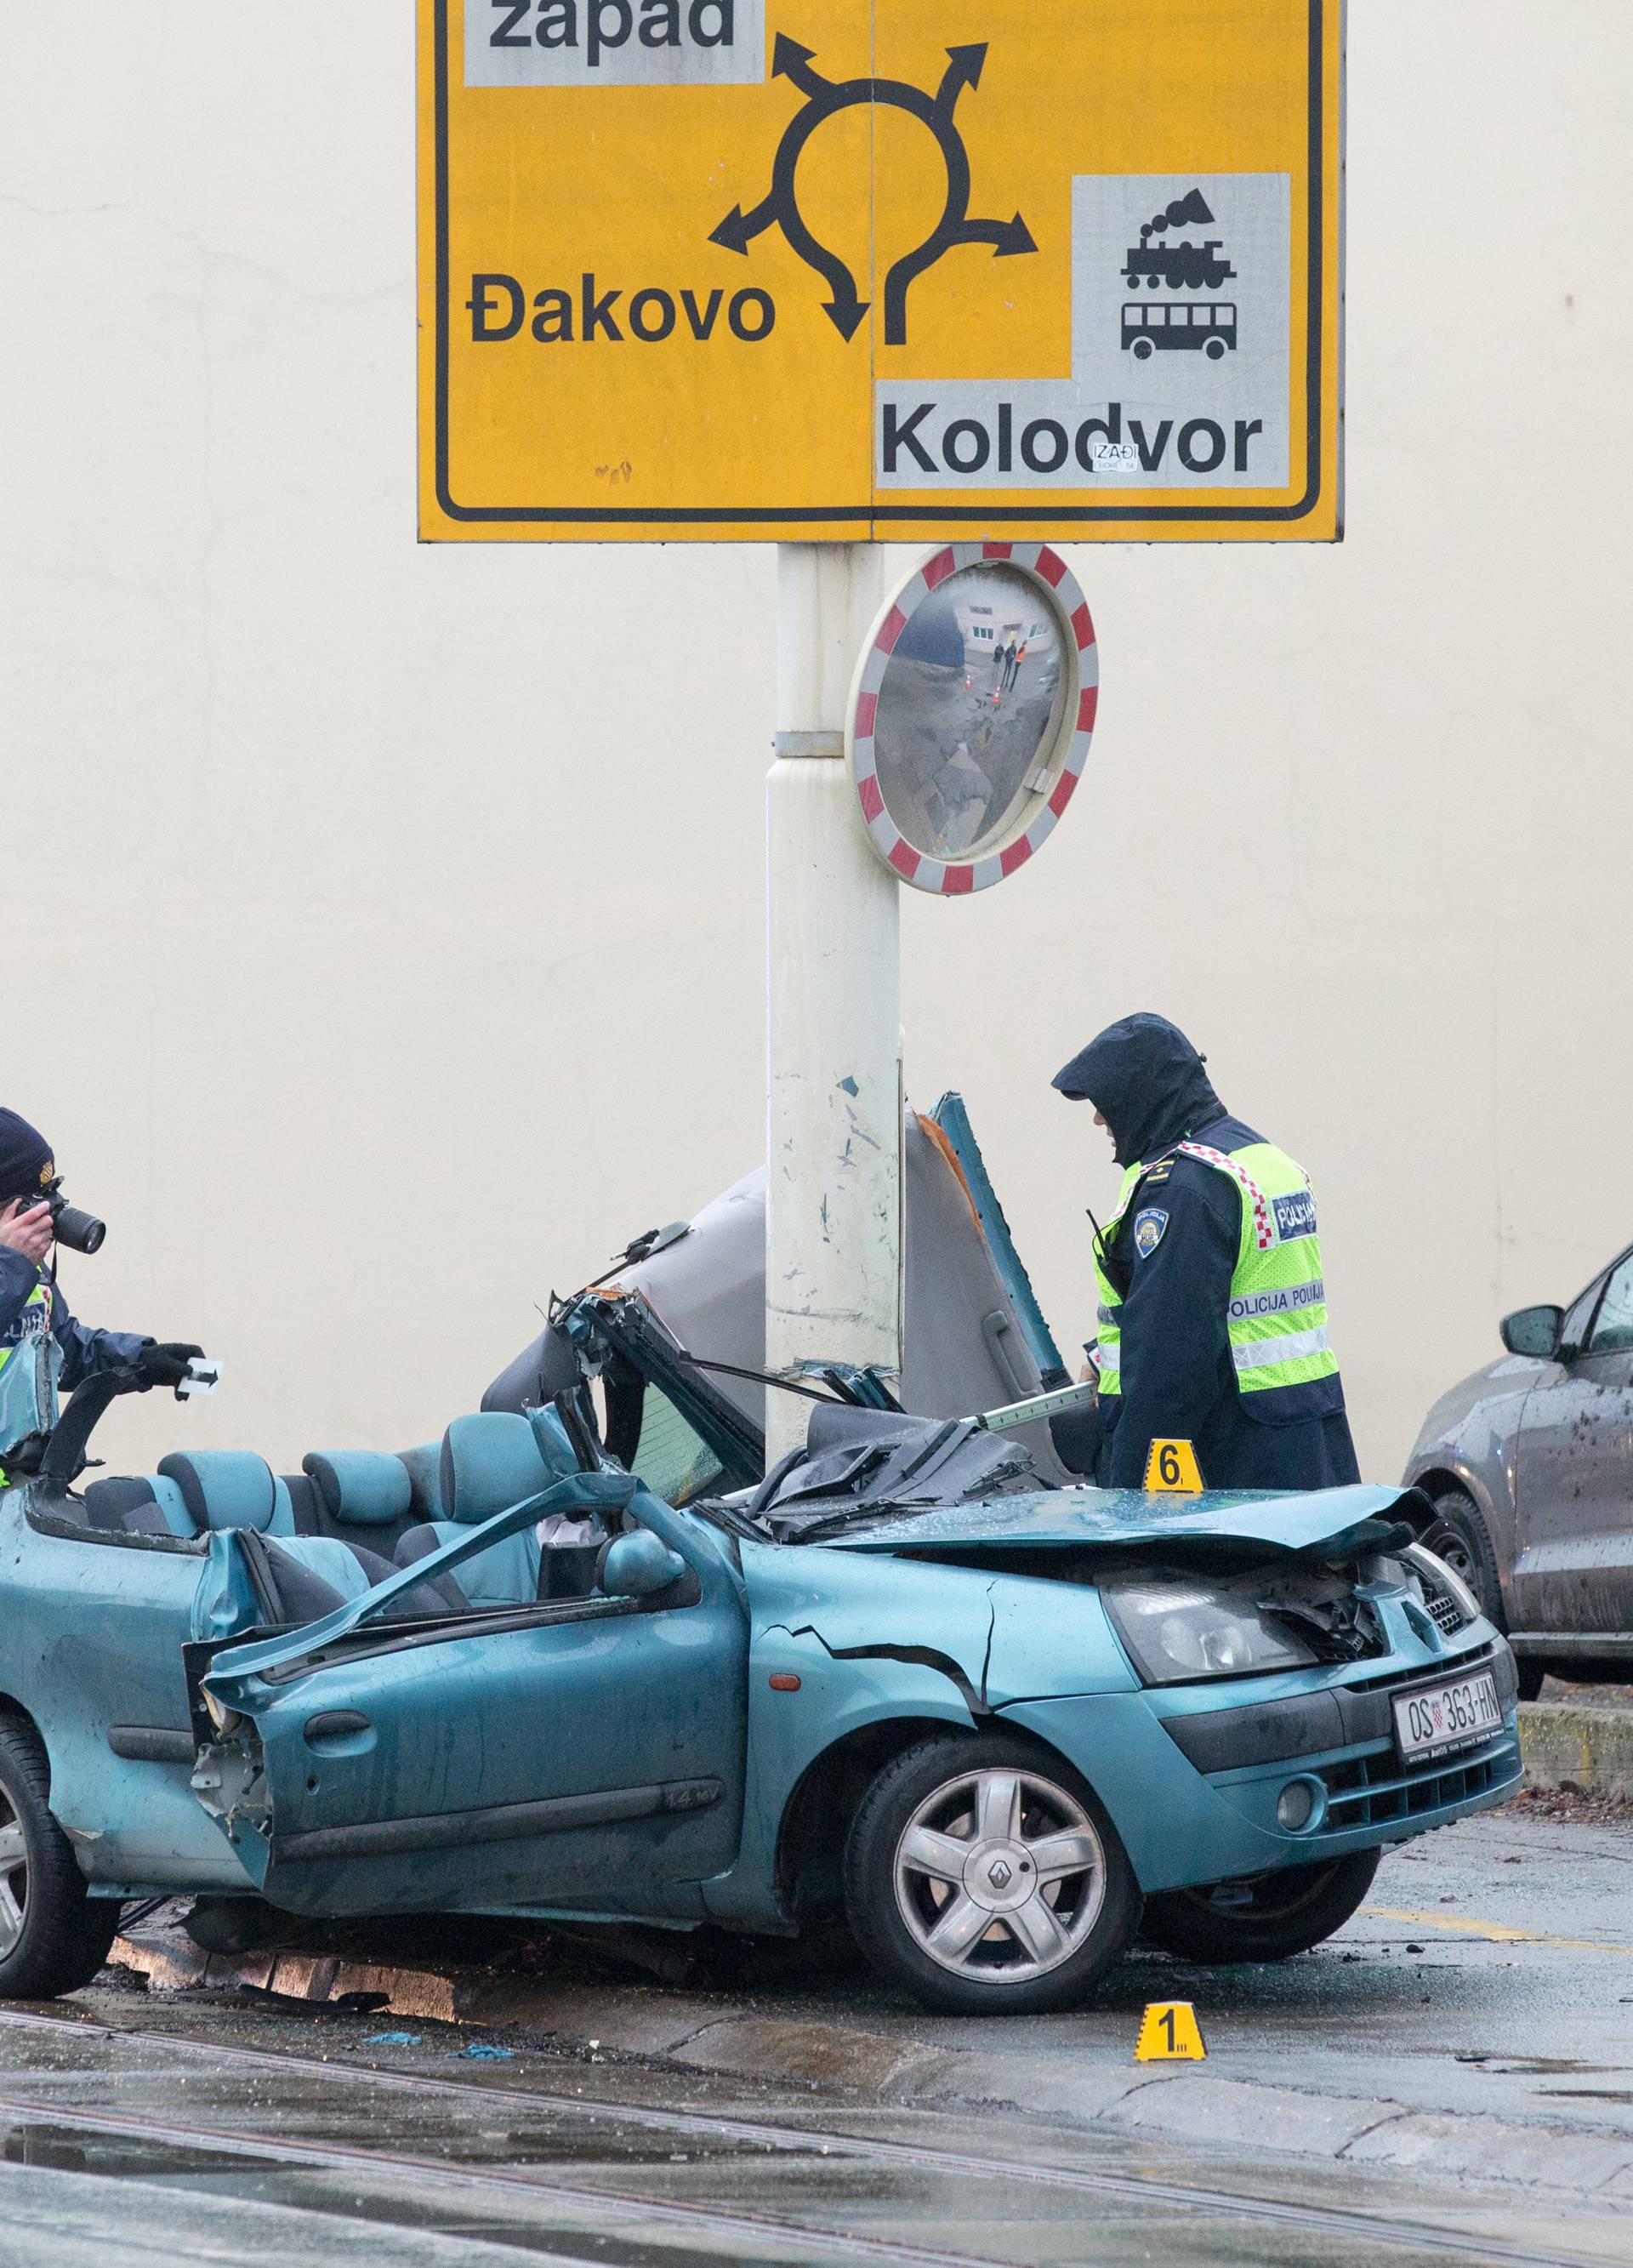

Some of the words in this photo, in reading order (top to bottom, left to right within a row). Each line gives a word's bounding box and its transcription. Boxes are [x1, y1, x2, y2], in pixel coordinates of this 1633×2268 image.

[465, 273, 776, 343] Đakovo
[883, 402, 1263, 474] Kolodvor
[1228, 1292, 1288, 1318] OLICIJA
[1159, 1444, 1181, 1485] 6
[1408, 1698, 1434, 1742] OS
[1442, 1678, 1499, 1730] 363-HN
[1158, 2008, 1175, 2053] 1
